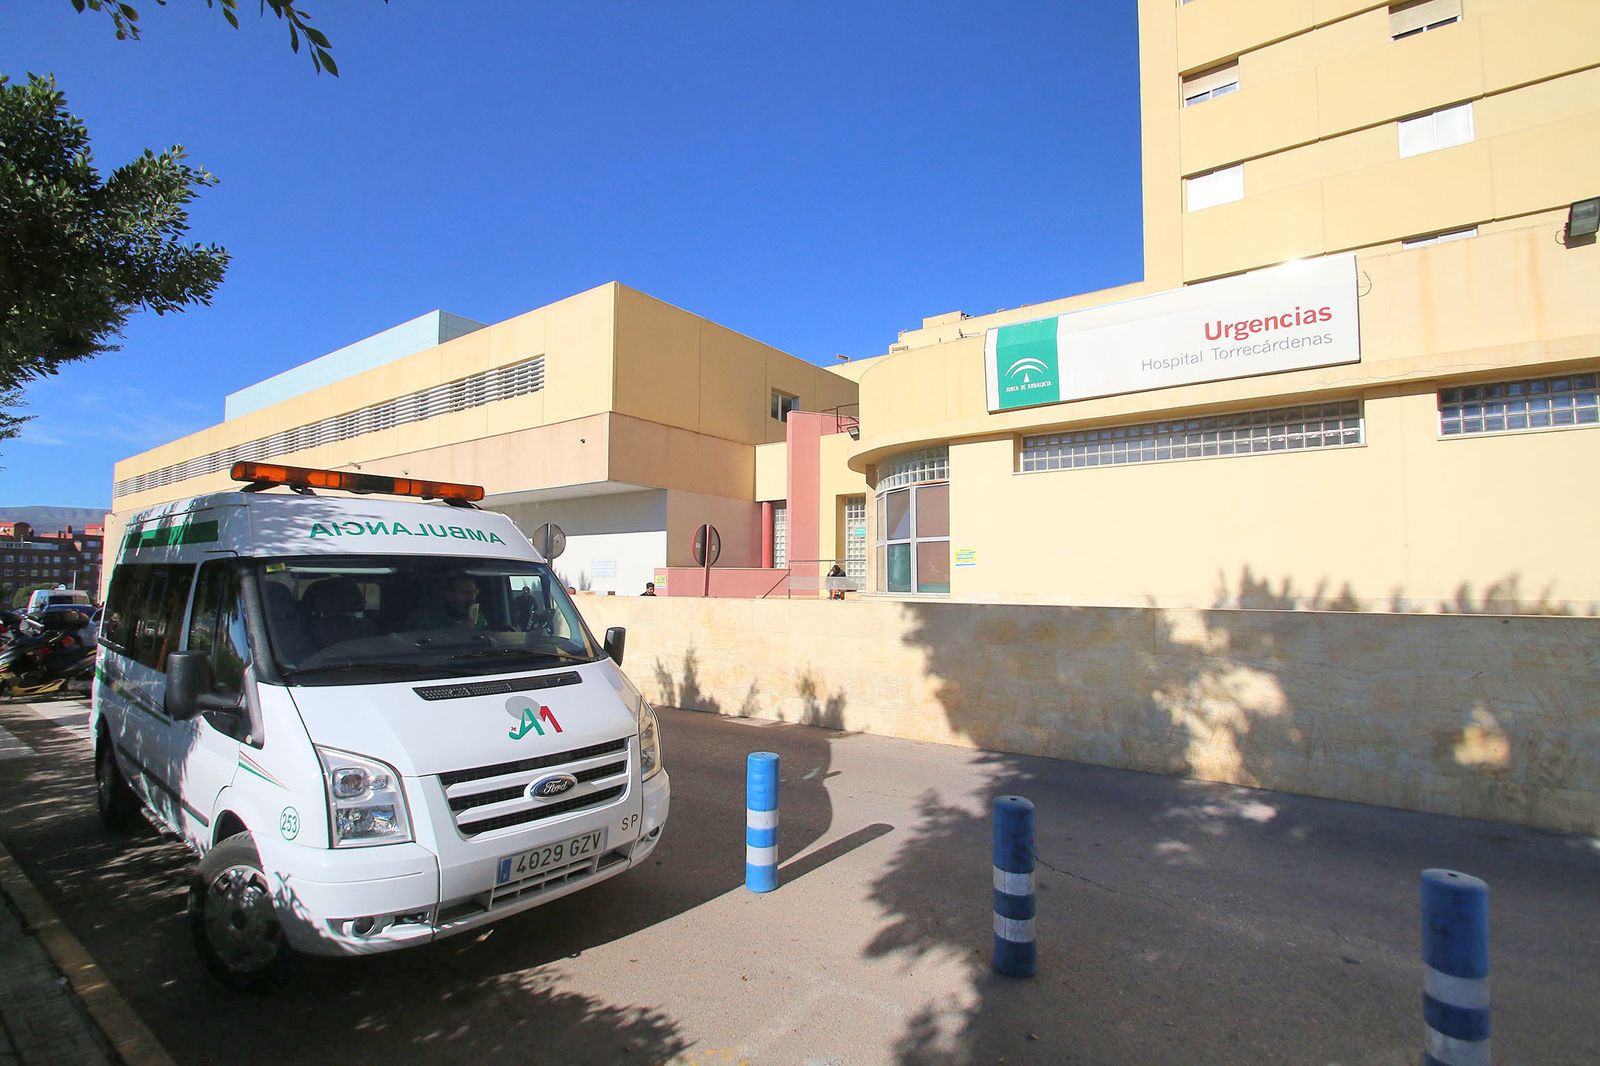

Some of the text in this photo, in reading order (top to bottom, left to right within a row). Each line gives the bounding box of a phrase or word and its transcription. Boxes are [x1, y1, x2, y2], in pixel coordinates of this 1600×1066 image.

[1204, 306, 1332, 341] Urgencias
[1141, 332, 1333, 371] Hospital Torrecárdenas
[543, 780, 569, 795] Ford
[281, 813, 297, 833] 253
[516, 831, 602, 874] 4029 GZV
